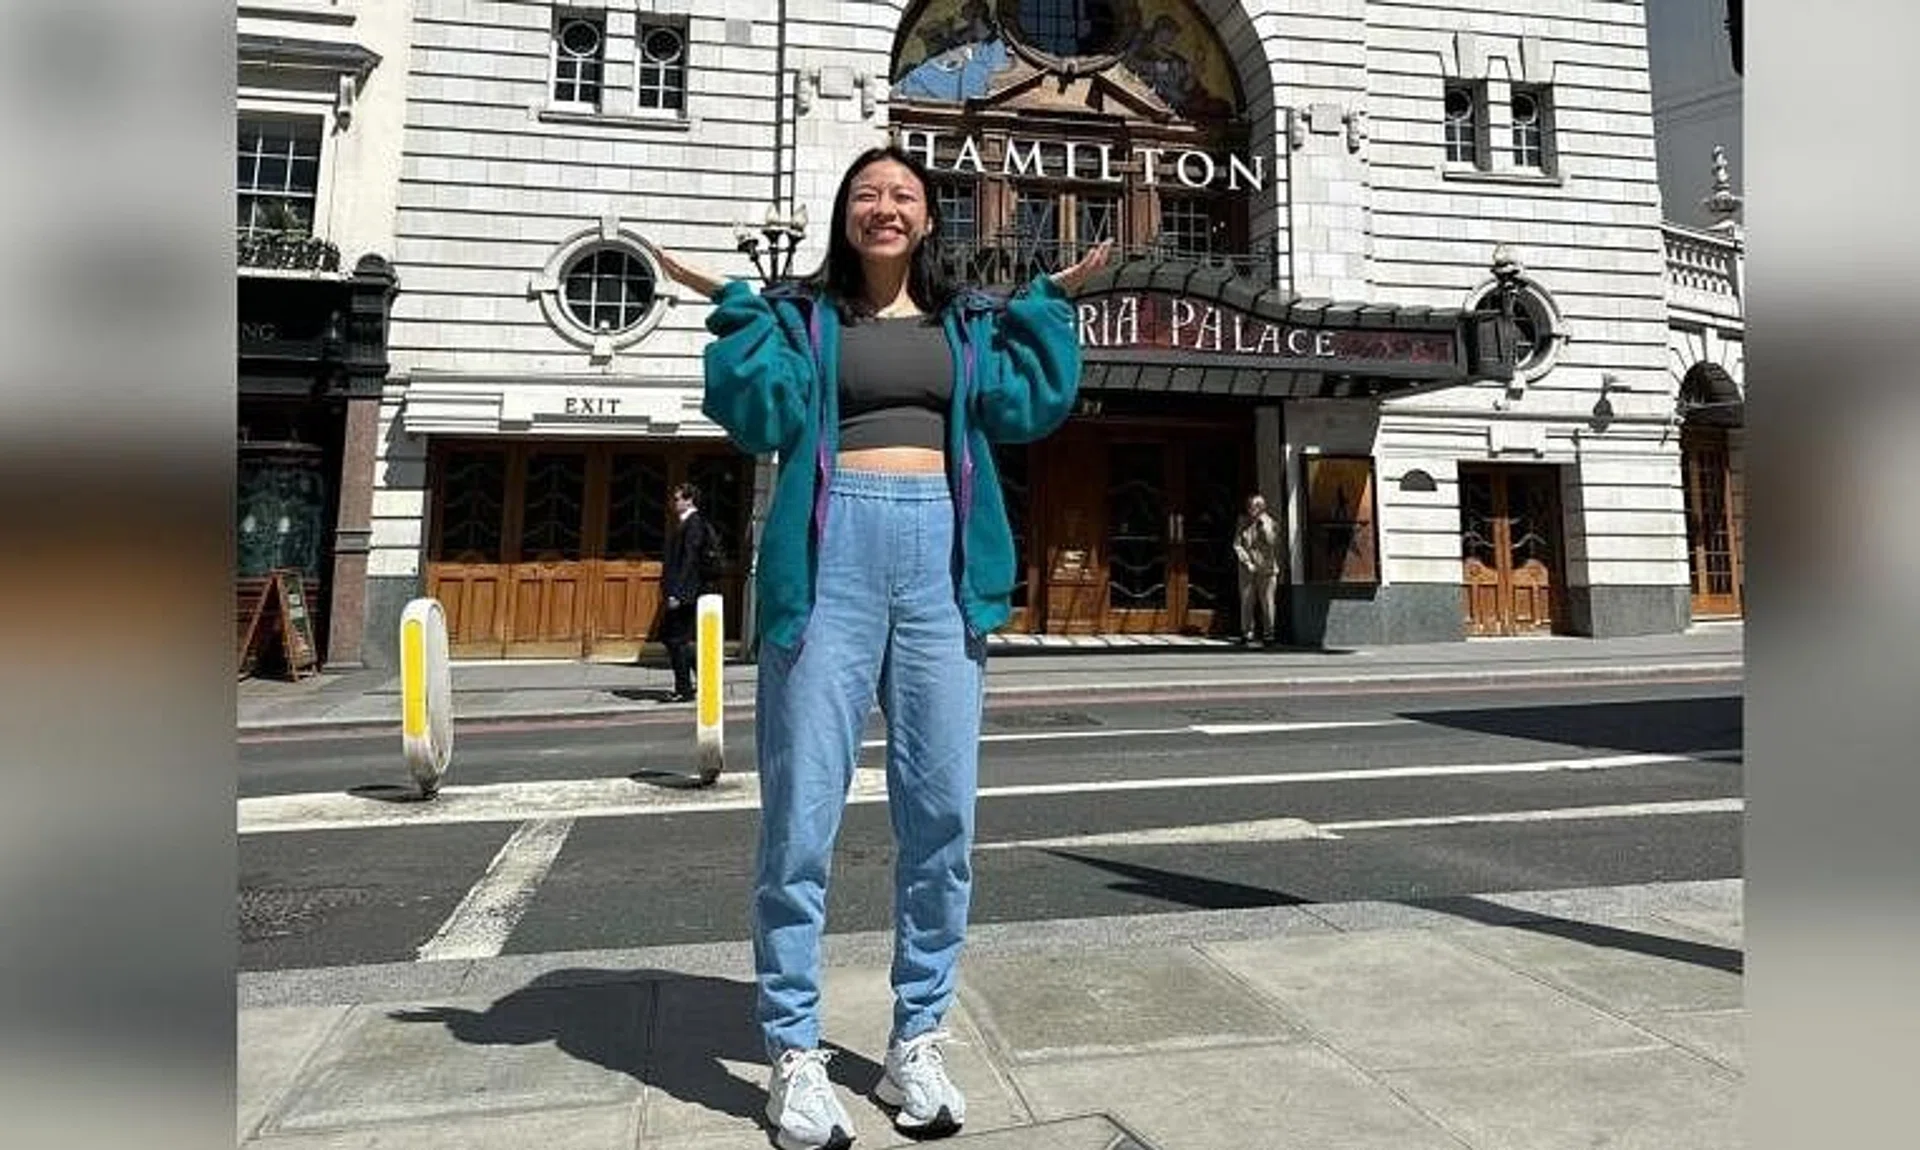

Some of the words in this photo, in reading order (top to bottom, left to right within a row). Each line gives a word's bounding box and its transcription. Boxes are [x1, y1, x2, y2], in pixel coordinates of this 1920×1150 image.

[901, 130, 1265, 192] HAMILTON
[1172, 299, 1336, 357] PALACE
[566, 397, 622, 414] EXIT
